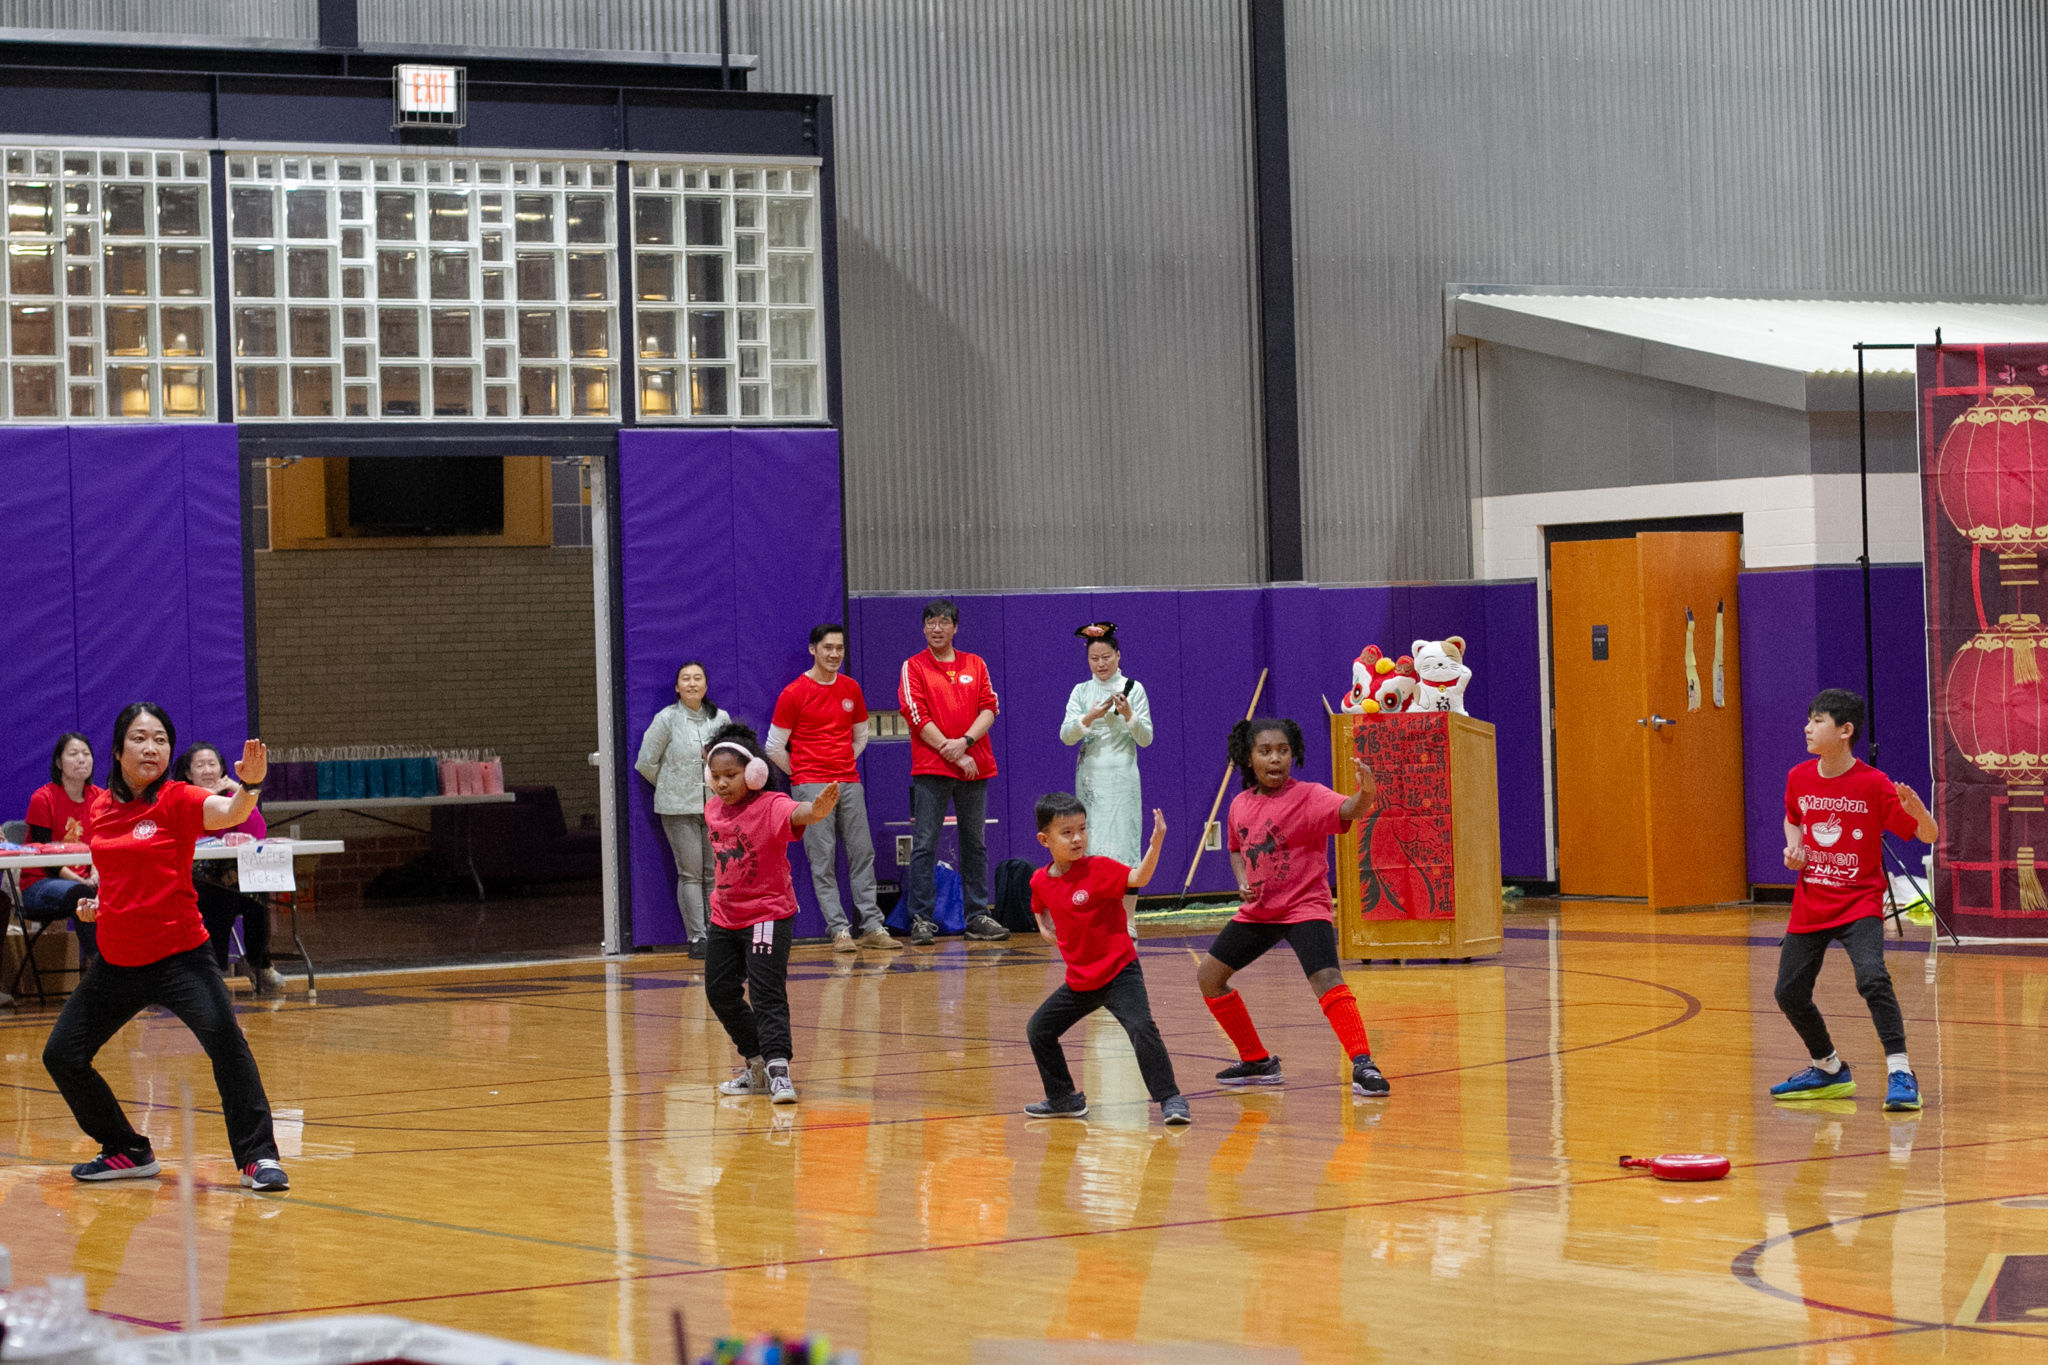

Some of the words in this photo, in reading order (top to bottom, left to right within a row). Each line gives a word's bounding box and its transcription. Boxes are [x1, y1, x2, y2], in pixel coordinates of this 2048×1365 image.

[413, 73, 447, 104] EXIT
[1354, 724, 1380, 755] 福
[1804, 795, 1865, 813] Maruchan
